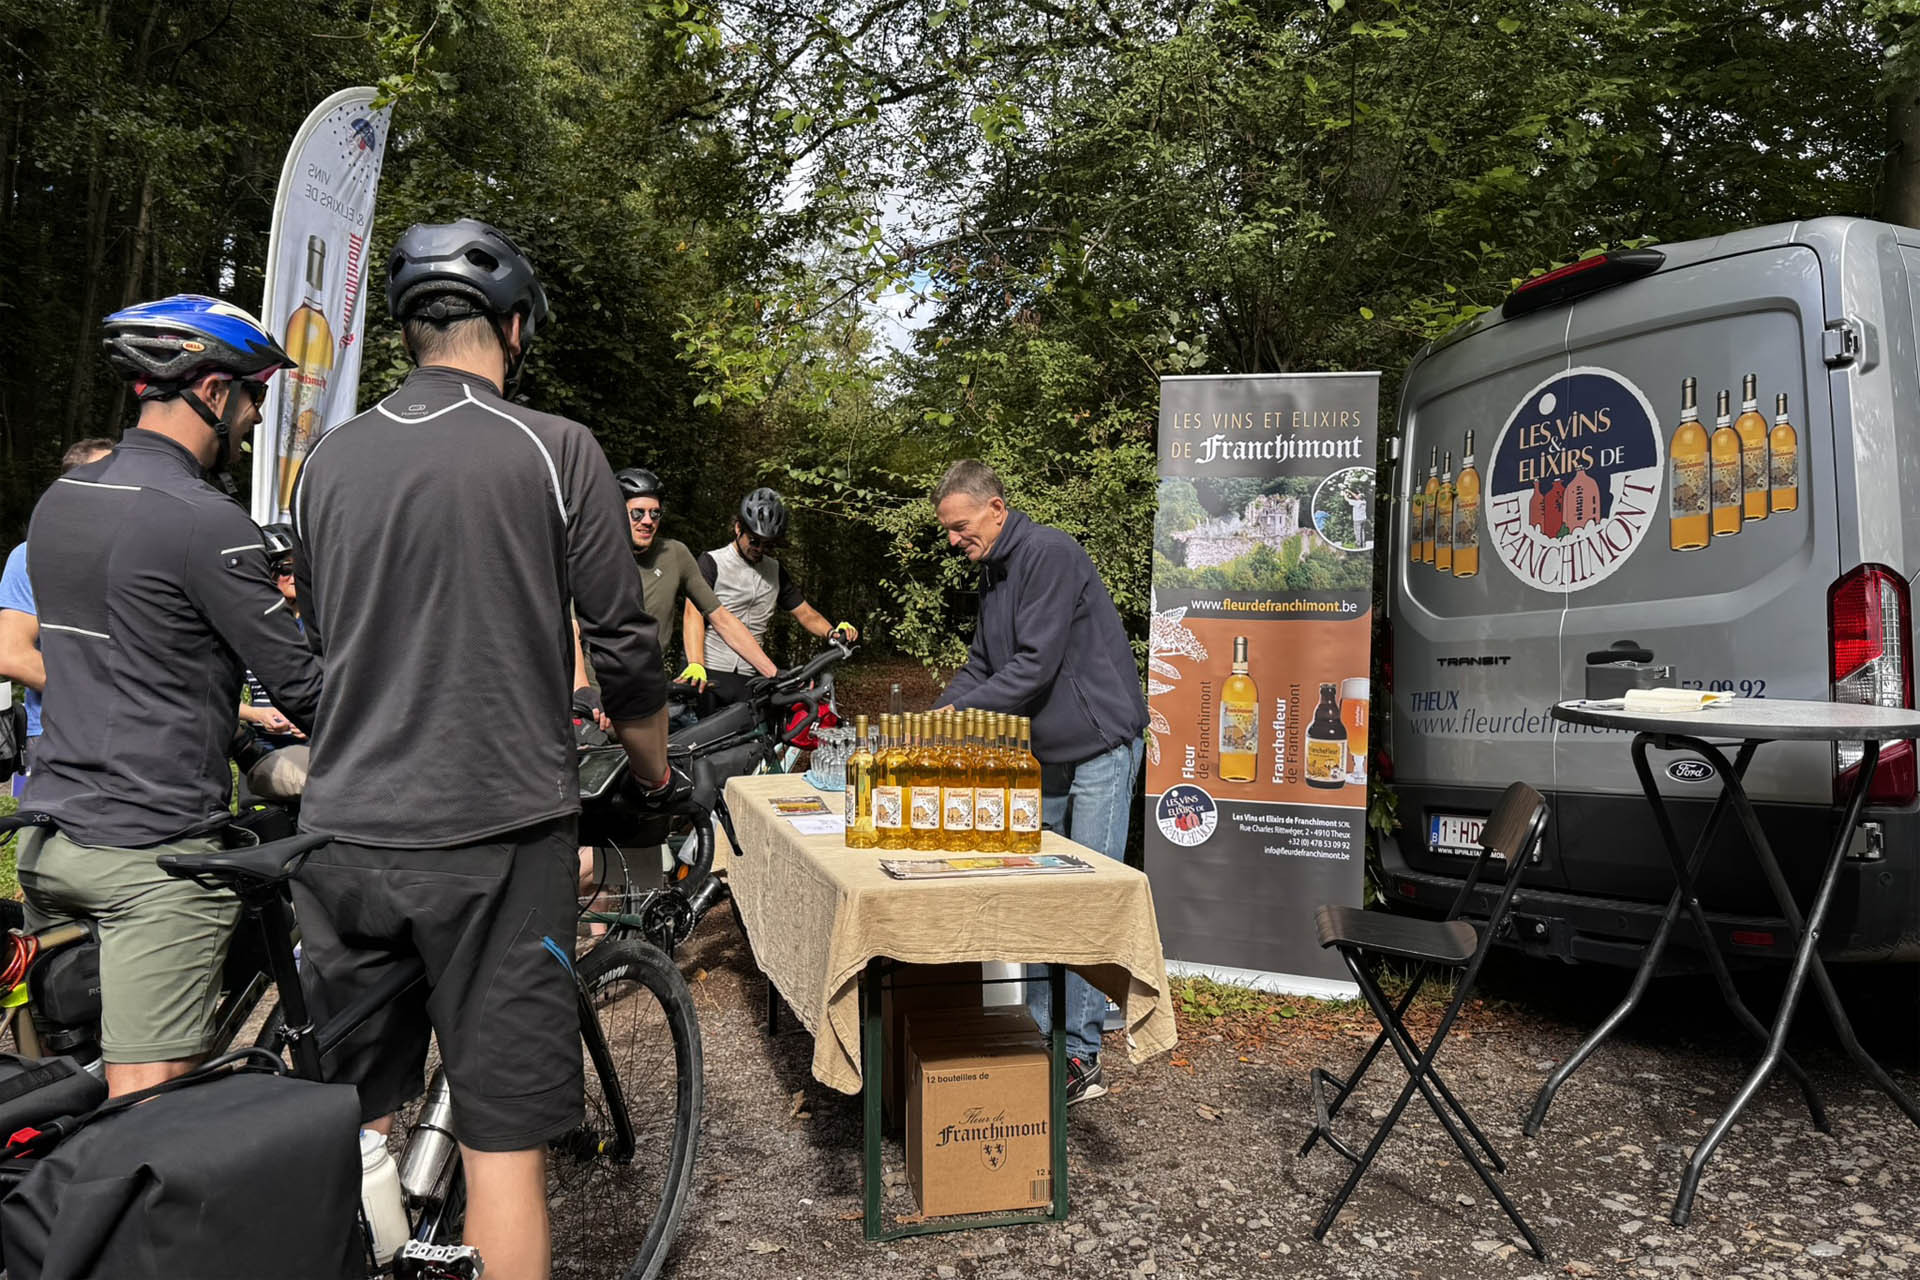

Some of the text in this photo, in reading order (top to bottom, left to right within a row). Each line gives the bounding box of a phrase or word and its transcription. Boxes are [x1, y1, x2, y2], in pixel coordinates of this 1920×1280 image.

[1174, 410, 1361, 429] LES VINS ET ELIXIRS
[1519, 407, 1611, 450] LES VINS
[1171, 433, 1363, 464] DE Franchimont
[1548, 435, 1562, 454] &
[1519, 445, 1625, 483] ELIXIRS DE
[1492, 474, 1656, 586] FRANCHIMONT
[1191, 598, 1357, 613] www.fleurdefranchimont.be
[1437, 656, 1511, 667] TRANSIT
[1739, 680, 1766, 698] 92
[1410, 690, 1459, 712] THEUX
[1197, 680, 1212, 780] de Franchimont
[1286, 683, 1300, 784] de Franchimont
[1272, 697, 1287, 784] Franchefleur
[1182, 744, 1196, 779] Fleur
[1676, 763, 1705, 778] Ford
[1232, 813, 1244, 821] Les
[1244, 814, 1258, 822] Vins
[1258, 815, 1266, 823] et
[1266, 815, 1285, 824] Elixirs
[1285, 816, 1294, 824] de
[1294, 817, 1337, 827] Franchimont
[1239, 824, 1251, 832] Rue
[1252, 824, 1274, 833] Charles
[1314, 829, 1331, 838] 4910
[1331, 830, 1351, 839] Theux
[1431, 832, 1439, 843] B
[1264, 846, 1350, 860] info@fleurdefranchimont.be
[1288, 838, 1351, 850] +32 (0) 478 53 09 92
[597, 964, 629, 988] MAVIC
[926, 1072, 990, 1084] 12 bouteilles de
[958, 1106, 1005, 1125] Fleur de
[936, 1119, 1048, 1147] Franchimont
[1036, 1168, 1046, 1176] 12
